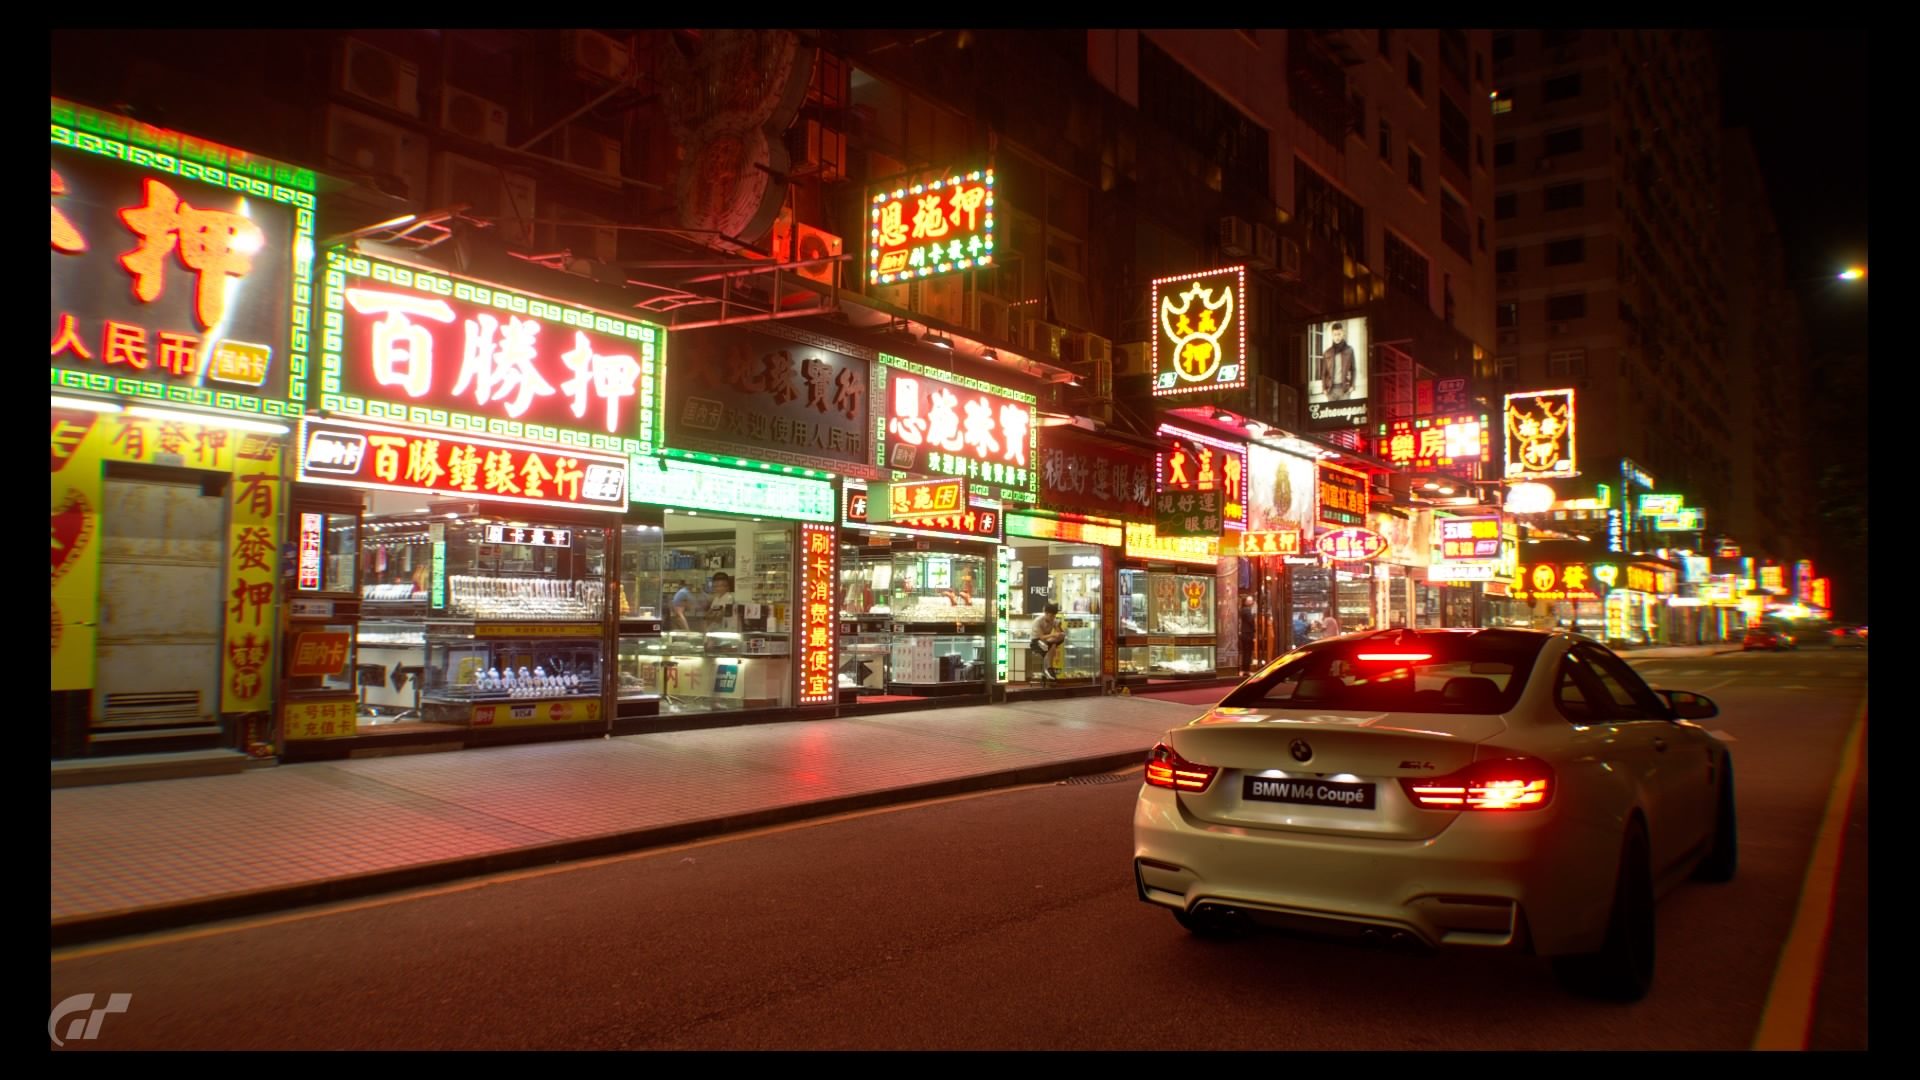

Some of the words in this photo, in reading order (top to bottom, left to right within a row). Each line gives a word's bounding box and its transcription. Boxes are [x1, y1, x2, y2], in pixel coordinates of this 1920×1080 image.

[879, 185, 985, 247] 恩施押
[51, 311, 201, 376] 人民币
[1182, 343, 1213, 374] 押
[217, 350, 267, 379] 国内卡
[345, 287, 642, 433] 百勝押
[889, 376, 1030, 467] 恩施珠寶
[1309, 403, 1368, 421] Extravagant
[113, 416, 229, 466] 有發押
[728, 406, 863, 457] 欢迎使用人民币
[1390, 427, 1446, 461] 藥房
[368, 434, 585, 501] 百勝鐘錶金行
[1044, 448, 1150, 506] 視好運眼鏡
[1157, 493, 1218, 513] 視好運
[983, 514, 993, 531] 卡
[1184, 515, 1220, 532] 眼鏡
[231, 471, 281, 628] 有發押
[808, 531, 830, 697] 刷卡消费最便宜
[296, 640, 346, 667] 国内卡
[236, 670, 258, 697] 押
[304, 703, 353, 720] 号码卡
[303, 720, 353, 737] 充值卡
[1252, 781, 1289, 797] BMW
[1291, 783, 1314, 799] M4
[1316, 786, 1365, 805] Coupé
